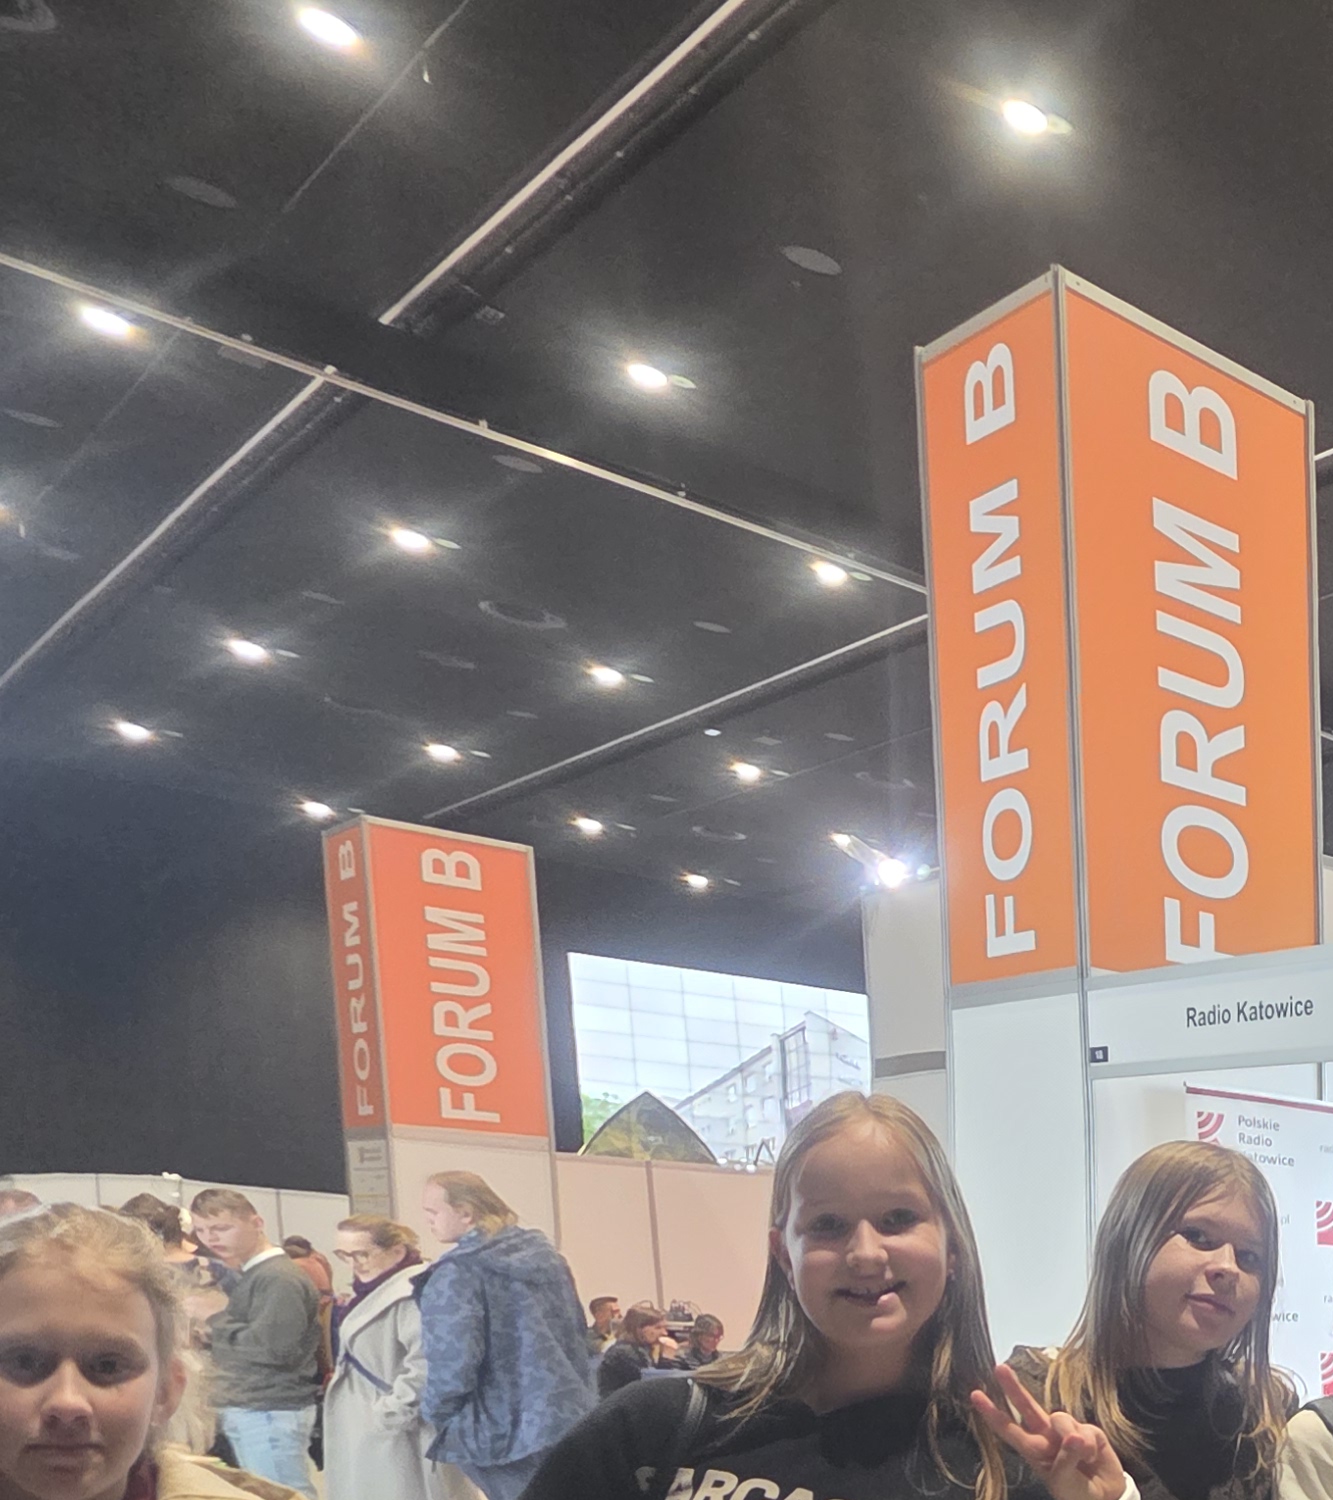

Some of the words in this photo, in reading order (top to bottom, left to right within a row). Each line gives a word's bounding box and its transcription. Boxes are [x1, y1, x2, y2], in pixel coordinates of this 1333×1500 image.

[964, 342, 1015, 445] B
[1148, 369, 1239, 481] B
[970, 478, 1036, 958] FORUM
[1151, 496, 1250, 965] FORUM
[338, 840, 356, 882] B
[421, 848, 483, 891] B
[342, 901, 374, 1116] FORUM
[424, 906, 501, 1123] FORUM
[1186, 1004, 1231, 1028] Radio
[1236, 995, 1314, 1023] Katowice
[1238, 1114, 1280, 1131] Polskie
[1238, 1132, 1273, 1147] Radio
